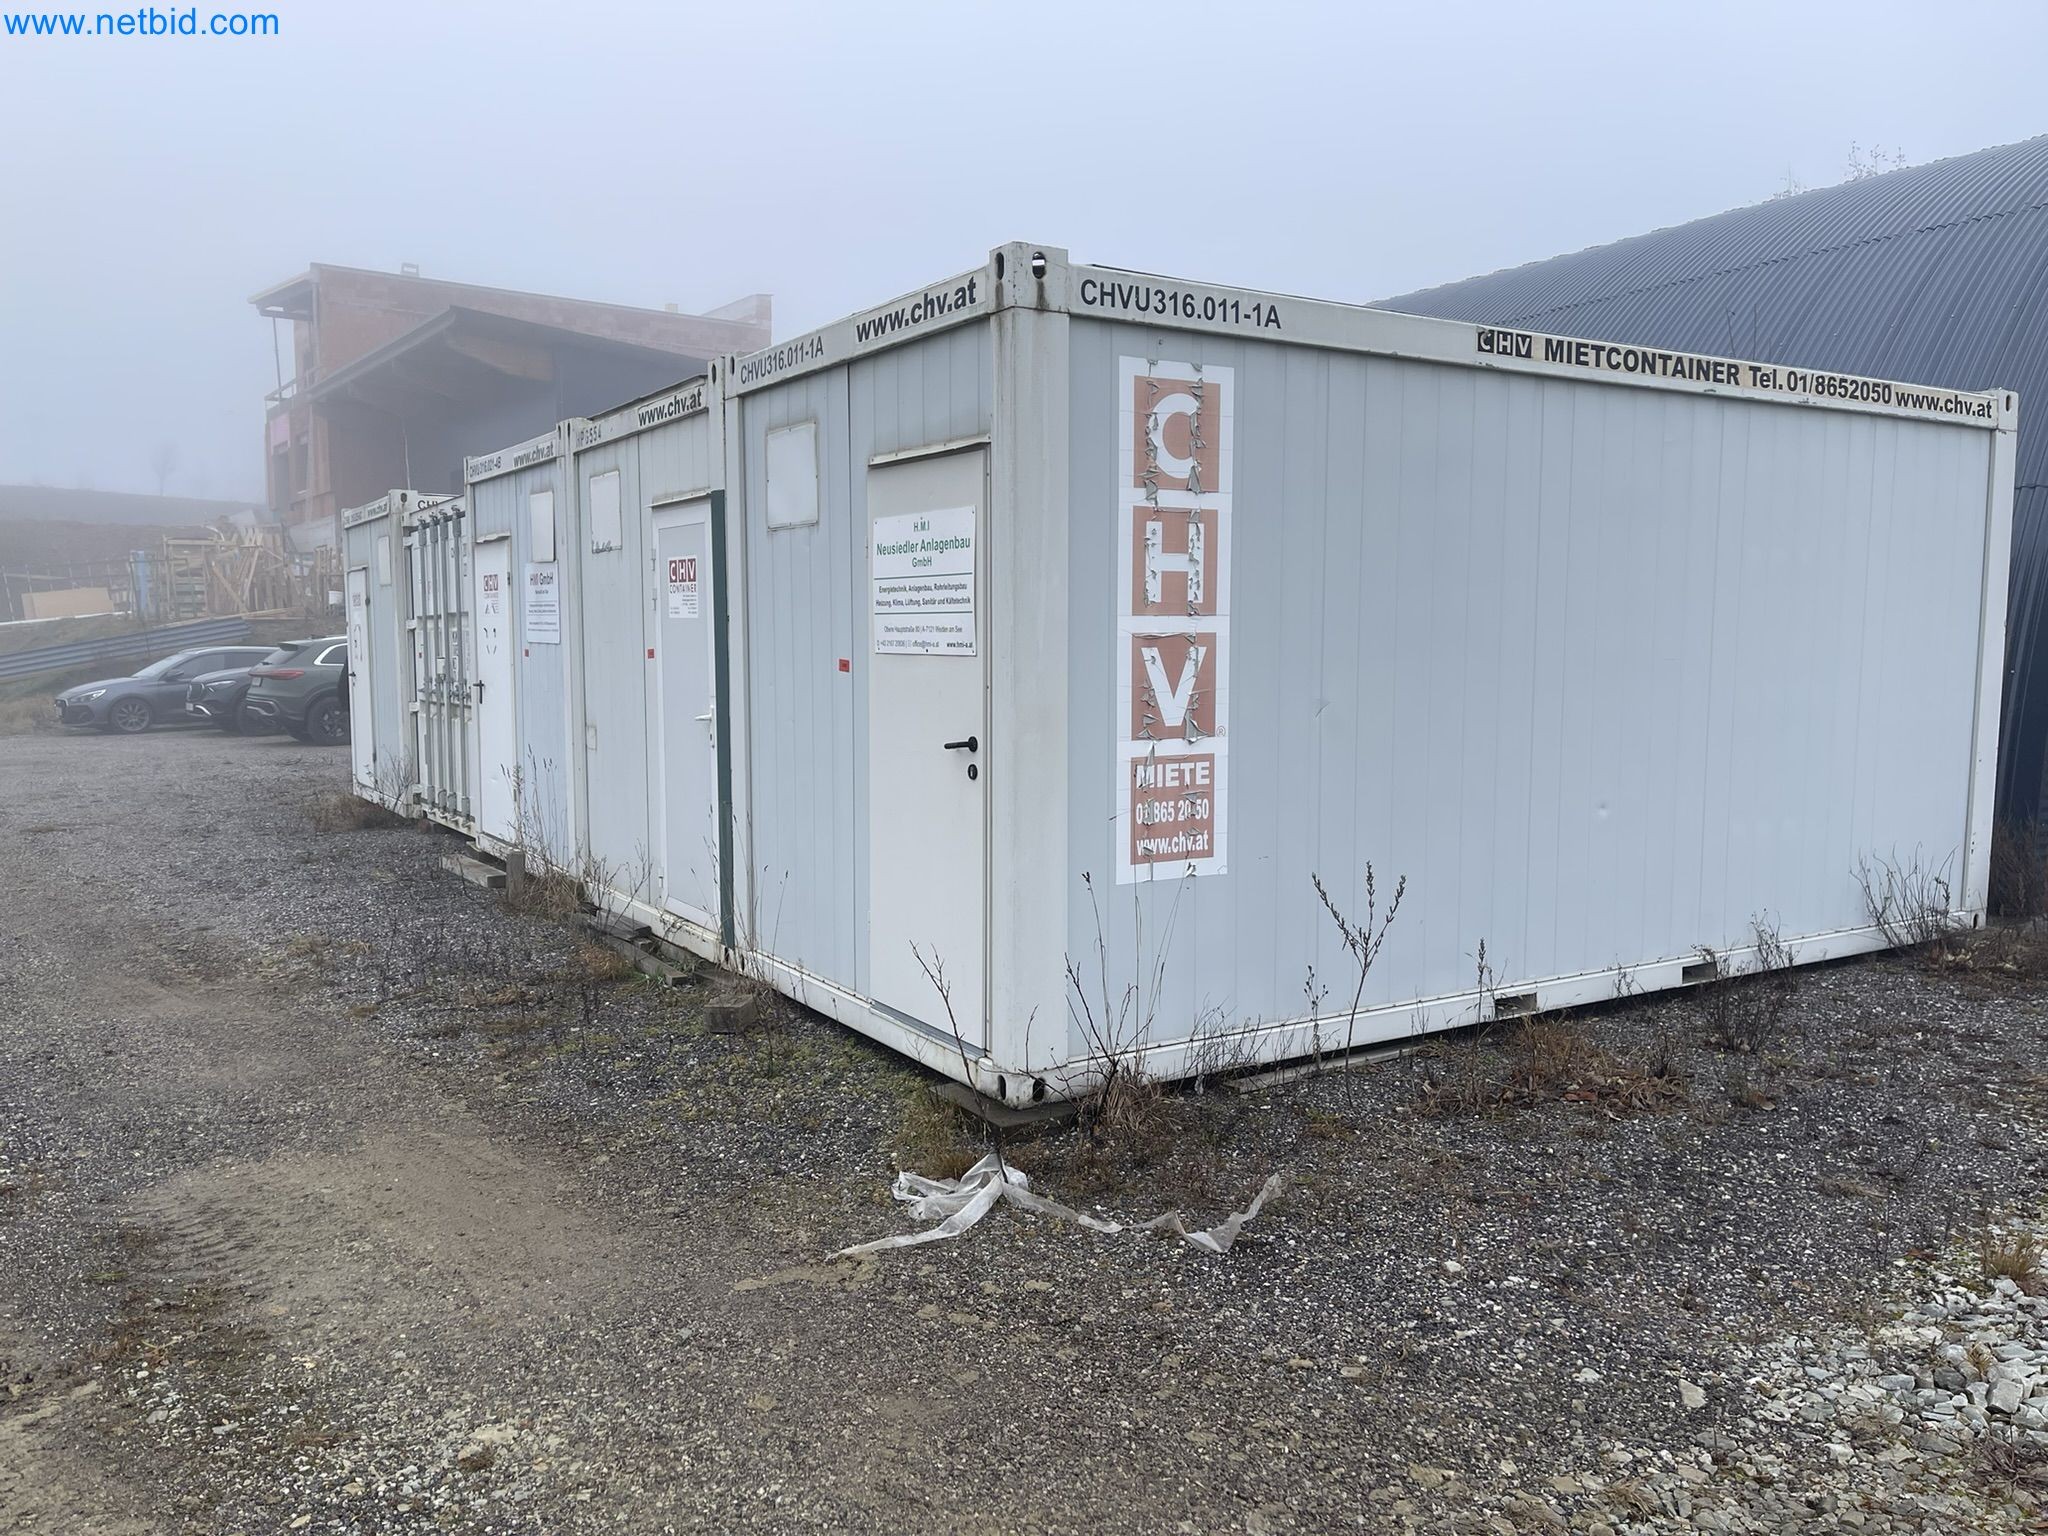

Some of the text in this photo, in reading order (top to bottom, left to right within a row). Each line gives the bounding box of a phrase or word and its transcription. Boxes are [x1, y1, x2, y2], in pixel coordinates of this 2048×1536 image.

[856, 275, 976, 342] www.chv.at
[1081, 279, 1281, 329] CHVU316.011-1A
[740, 335, 824, 384] CHVU316.011-1A
[1479, 331, 1992, 418] CHV MIETCONTAINER Tel. 01/8652050 www.chv.at
[638, 388, 702, 426] www.chv.at
[513, 441, 554, 468] www.chv.at
[876, 536, 971, 556] Neusiedler Anlagenbau
[669, 559, 696, 582] CHV
[912, 556, 933, 568] GmbH
[539, 572, 554, 585] GmbH
[670, 583, 697, 593] CONTAINER
[1136, 761, 1210, 789] MIETE
[1153, 801, 1175, 823] 865
[1136, 830, 1209, 856] www.chv.at
